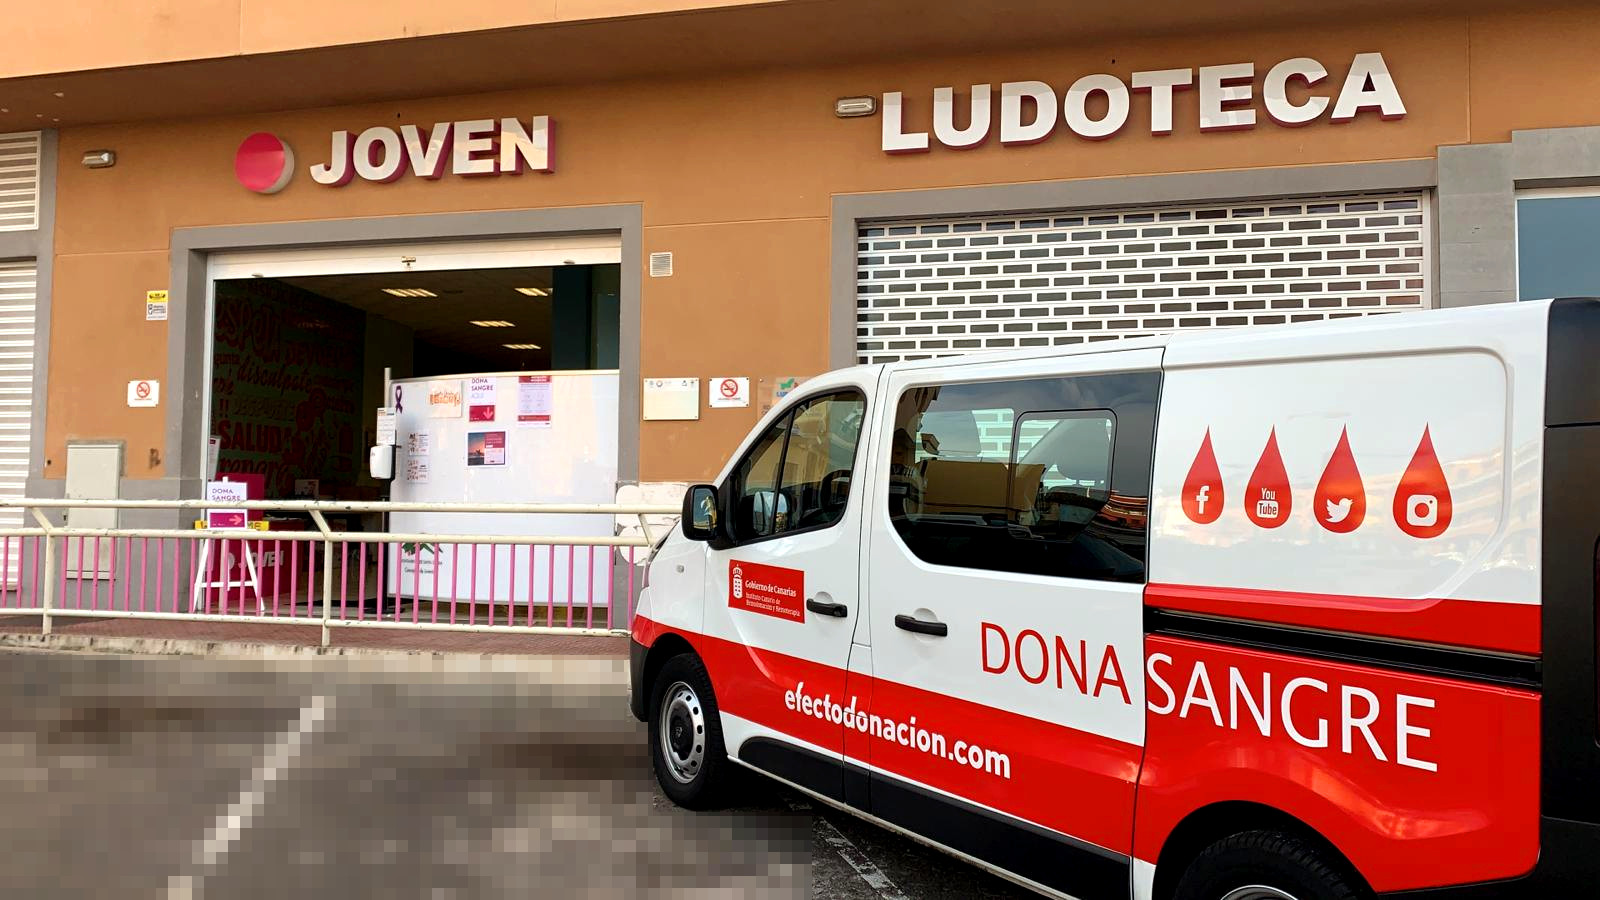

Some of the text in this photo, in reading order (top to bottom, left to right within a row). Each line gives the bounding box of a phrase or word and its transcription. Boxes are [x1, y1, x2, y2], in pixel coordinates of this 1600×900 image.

[882, 52, 1408, 153] LUDOTECA
[309, 115, 554, 187] JOVEN
[1258, 501, 1278, 516] Tube
[1261, 487, 1276, 501] You
[745, 580, 768, 590] Gobierno
[774, 585, 797, 597] Canarias
[980, 622, 1131, 705] DONA
[784, 681, 1011, 780] efectodonacion.com
[1146, 653, 1438, 772] SANGRE
